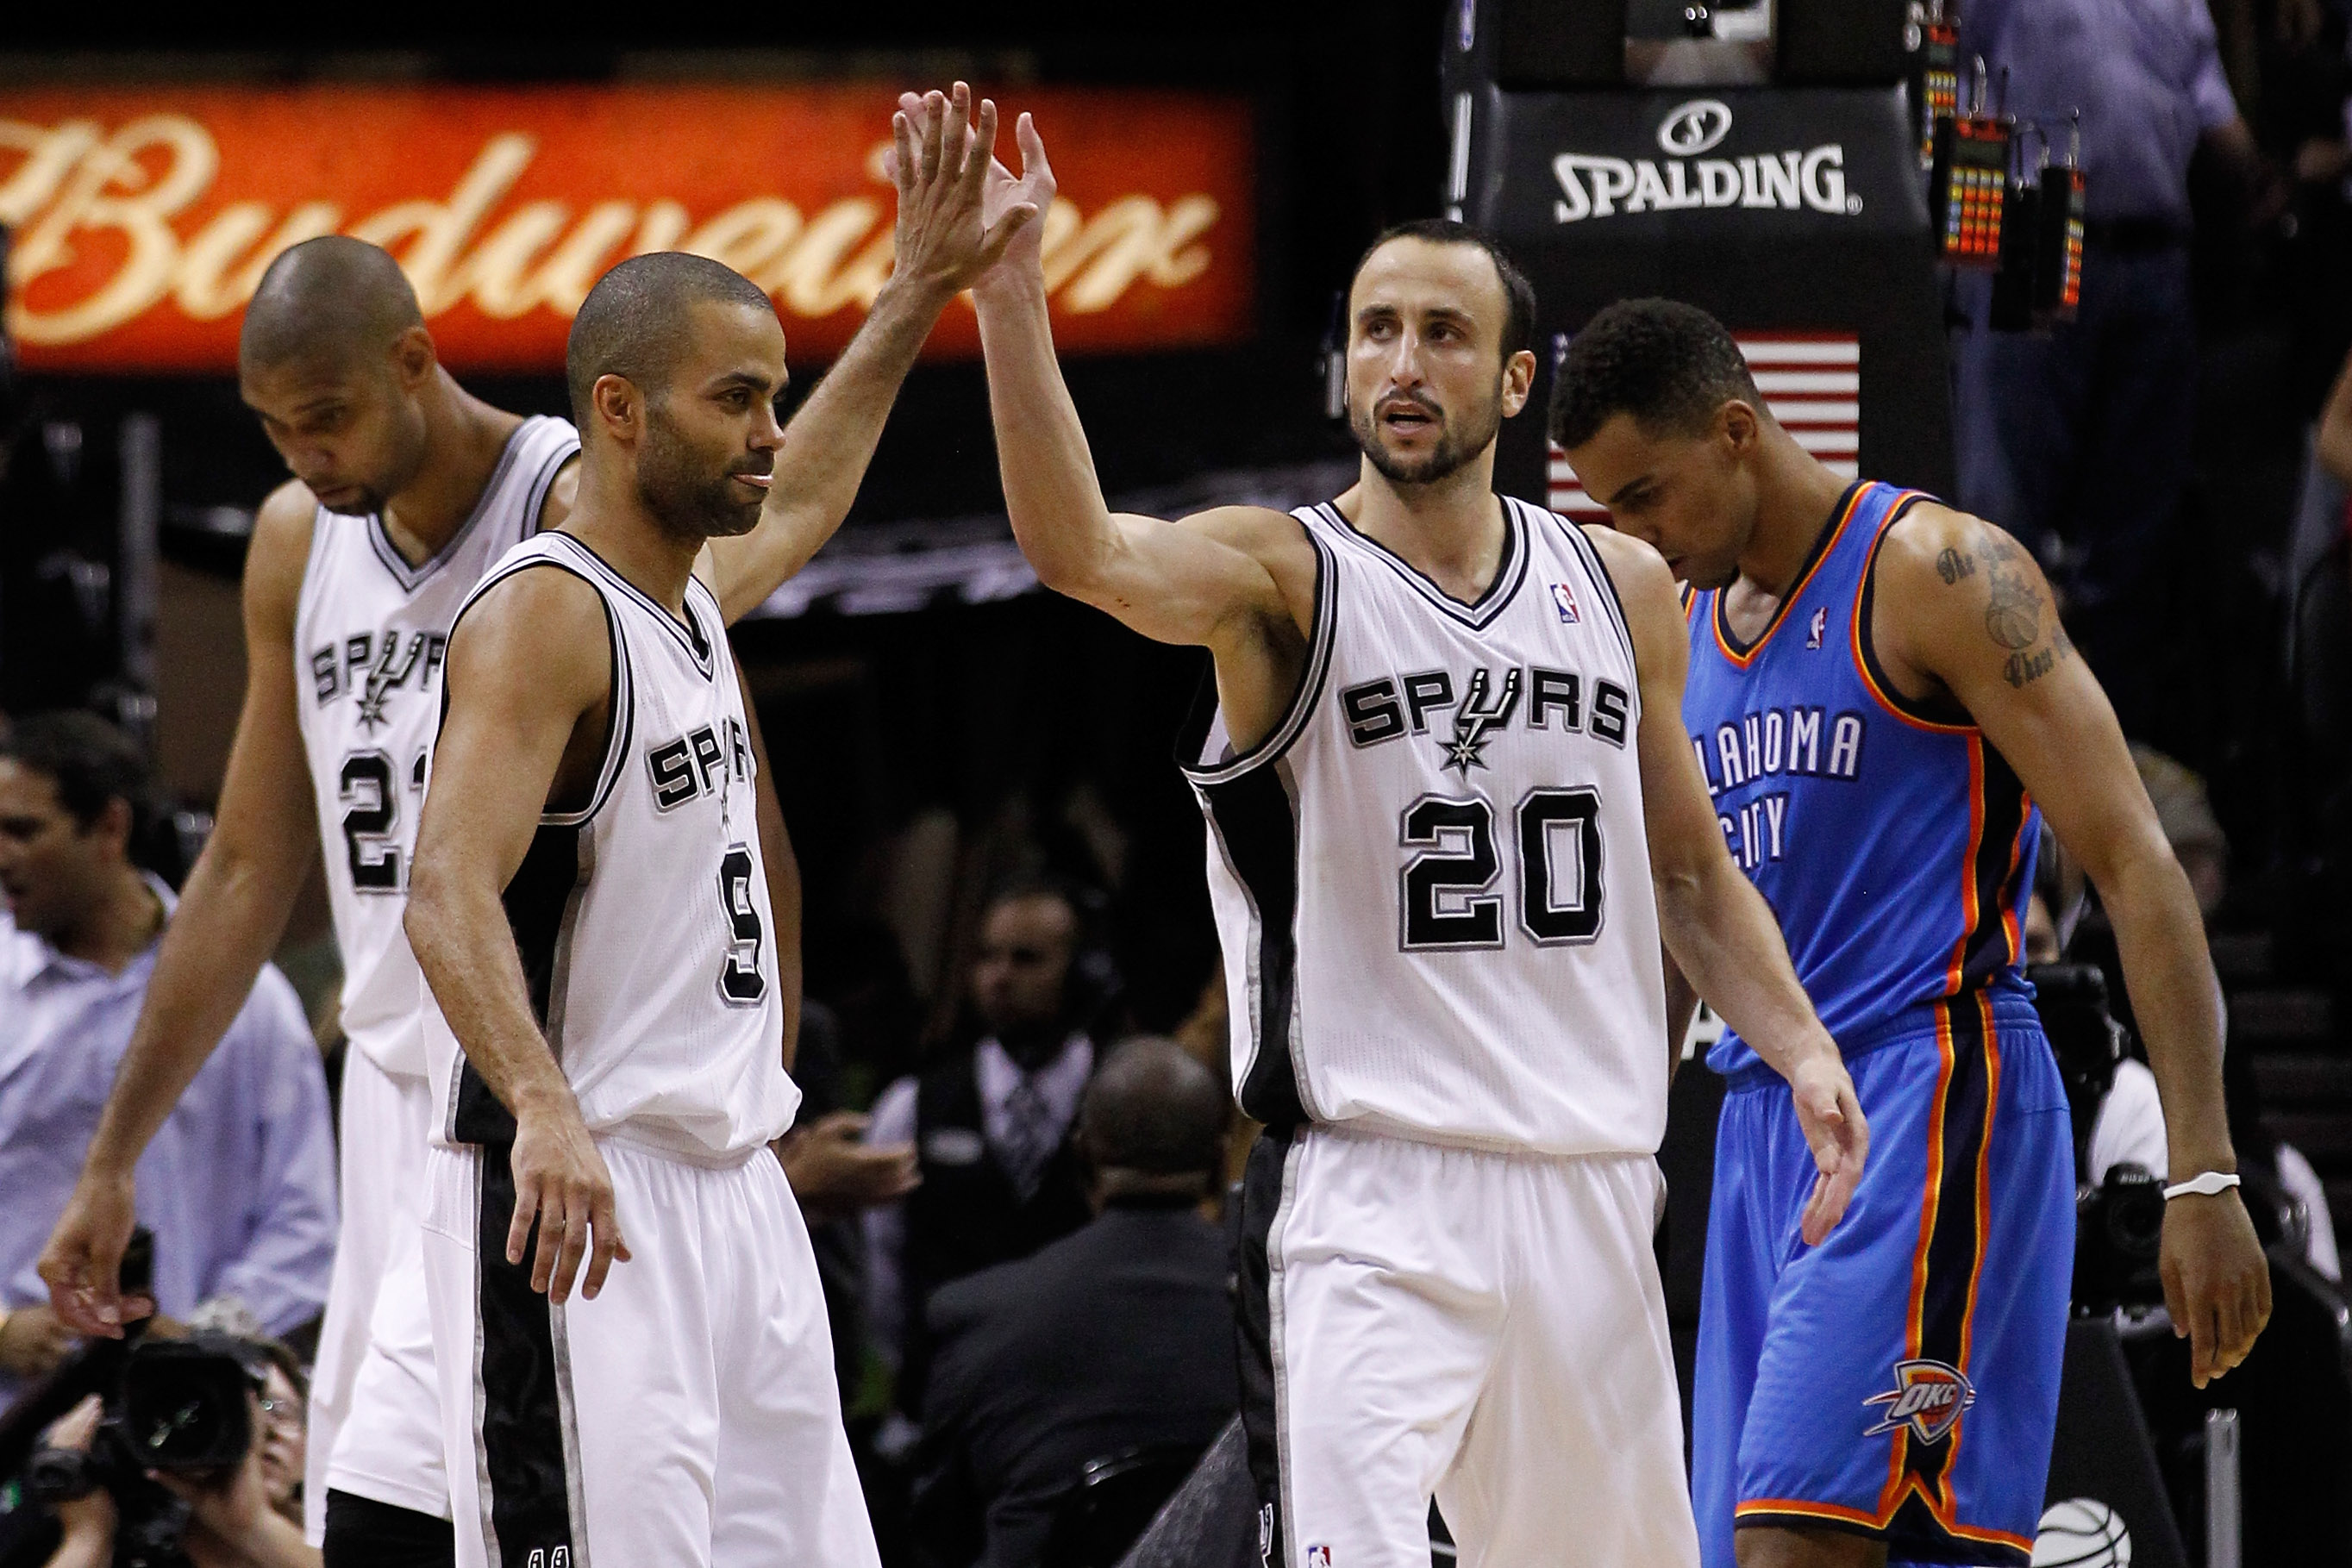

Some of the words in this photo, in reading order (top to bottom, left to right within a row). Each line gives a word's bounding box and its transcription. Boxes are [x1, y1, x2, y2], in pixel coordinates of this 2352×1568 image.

[0, 112, 1222, 346] Budweir
[1554, 142, 1846, 224] SPALDING
[1338, 667, 1633, 754] SPURS
[339, 745, 431, 895] 2
[1398, 784, 1607, 953] 20
[717, 842, 768, 1009] 9
[1889, 1382, 1958, 1419] OKC
